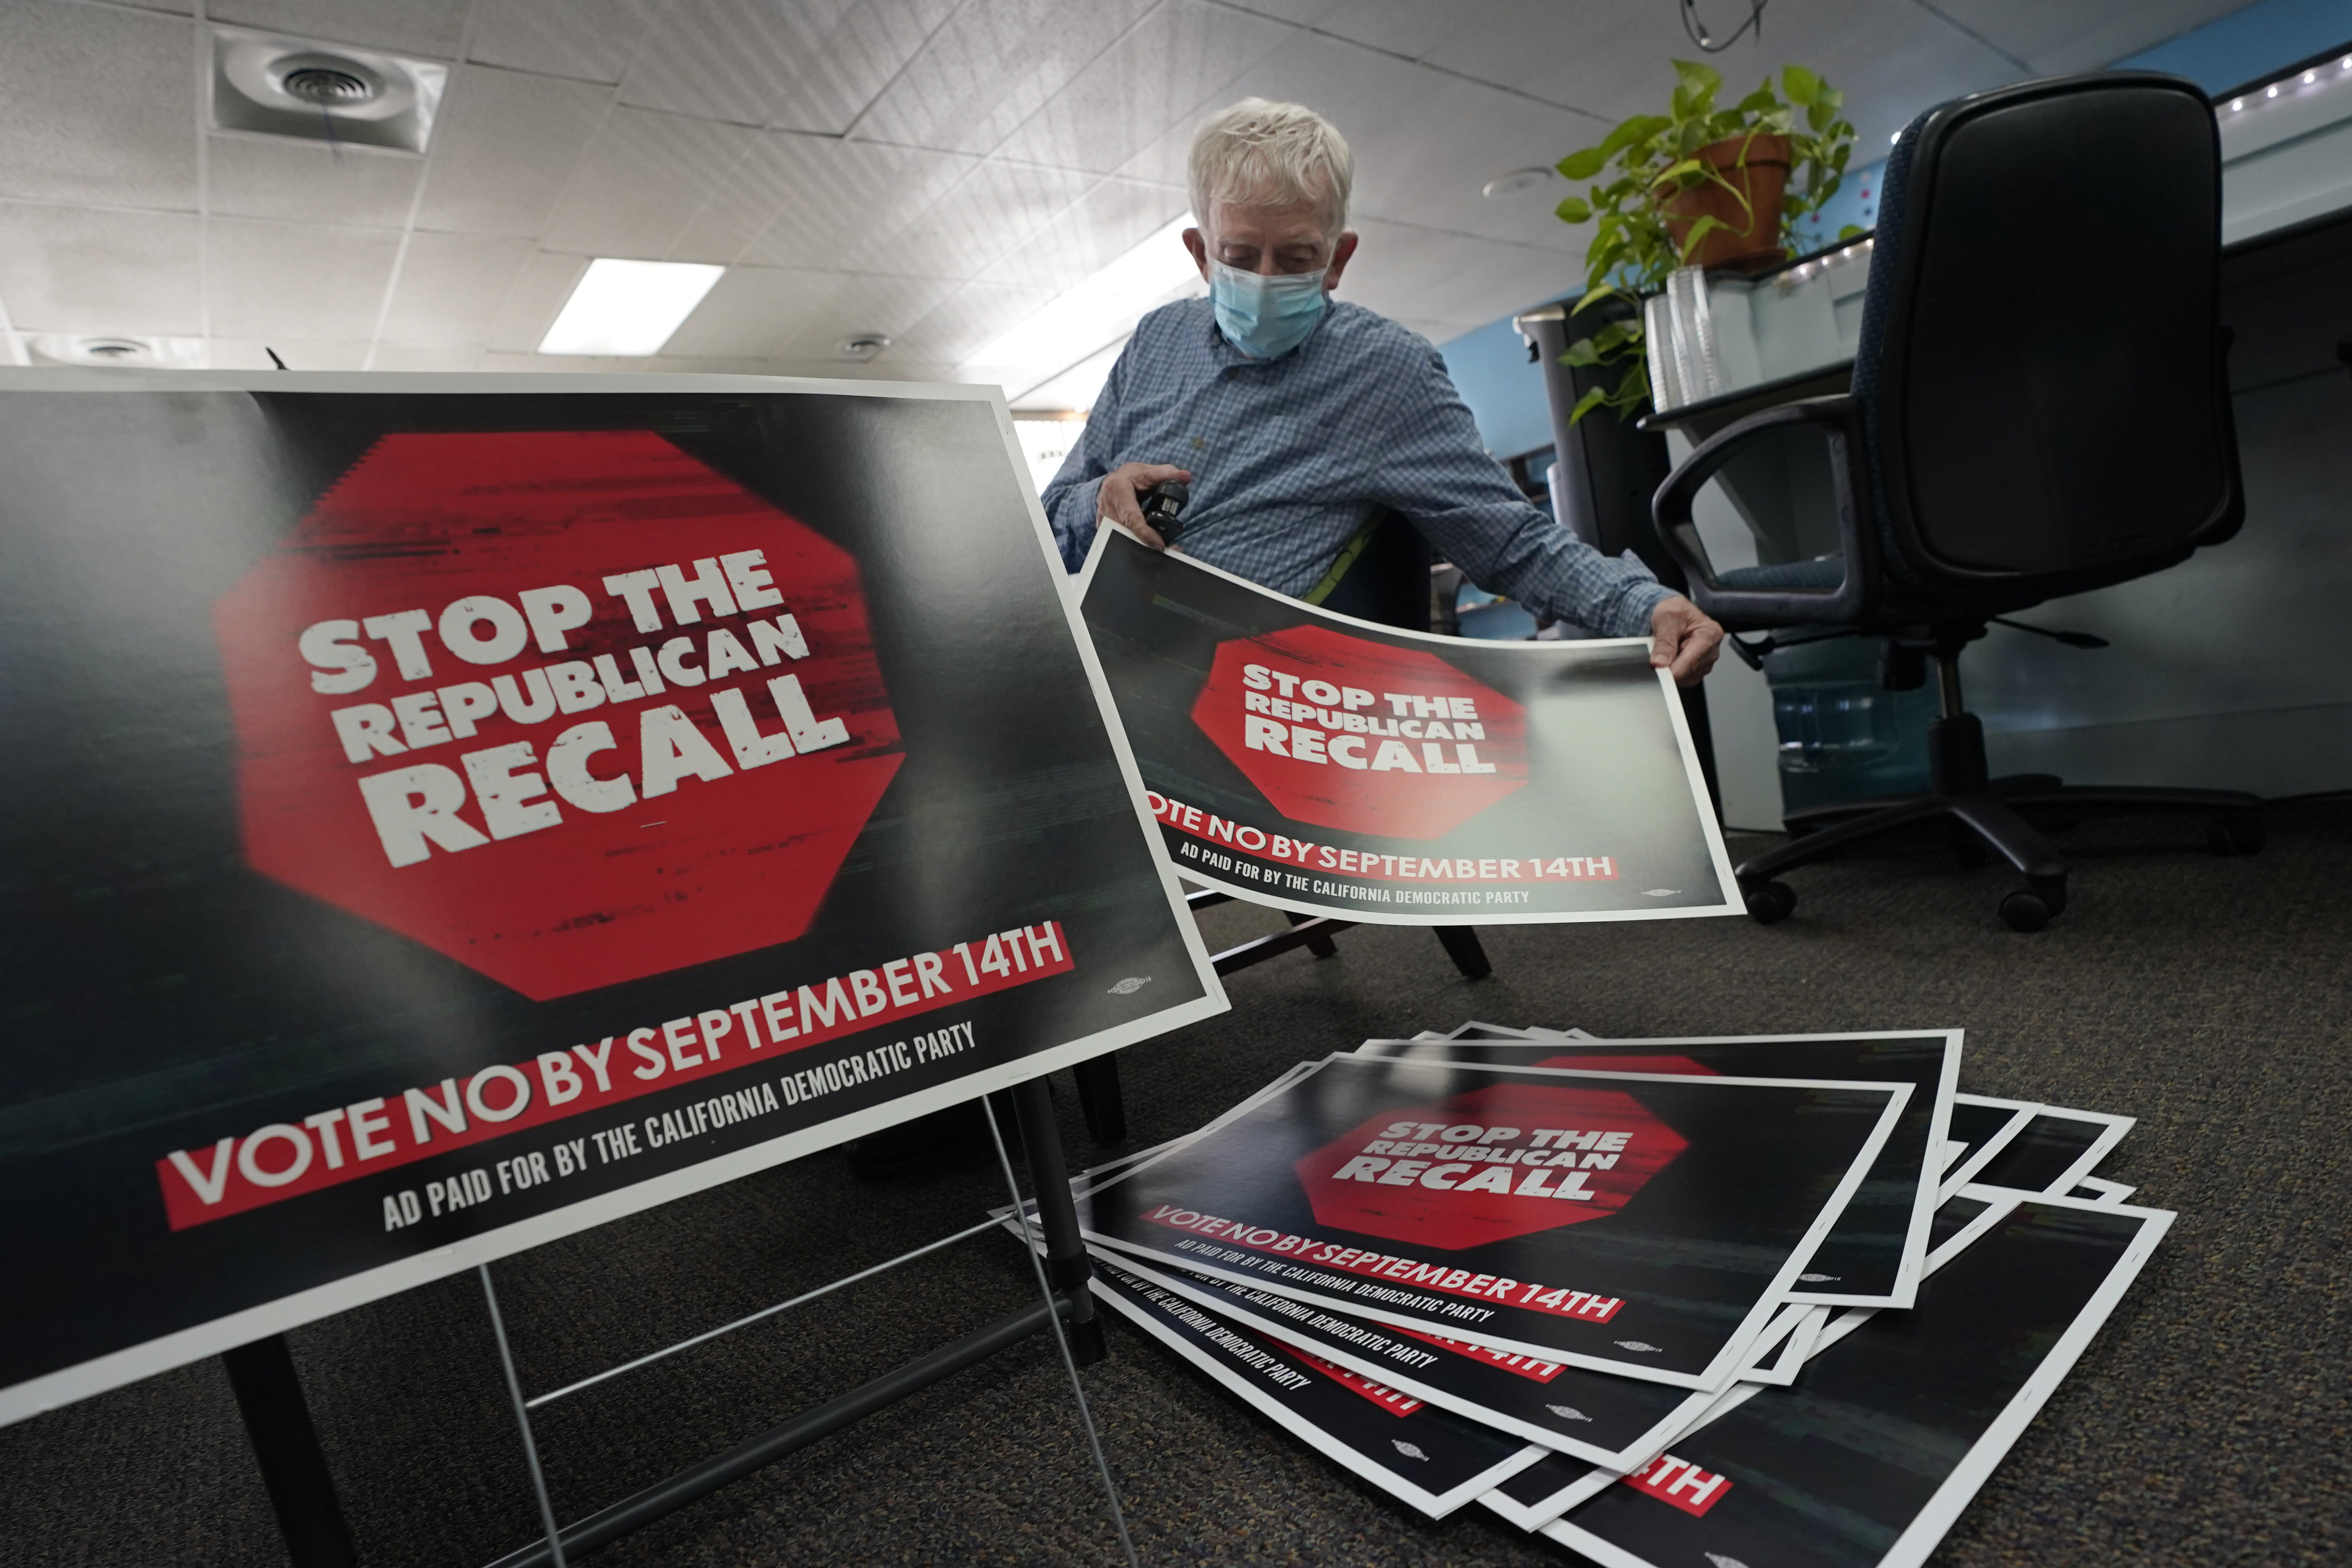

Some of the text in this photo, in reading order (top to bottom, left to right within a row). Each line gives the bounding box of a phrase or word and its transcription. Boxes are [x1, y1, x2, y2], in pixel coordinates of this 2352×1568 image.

[298, 549, 784, 694] STOP THE
[331, 614, 810, 763] REPUBLICAN
[1243, 664, 1478, 720] STOP THE
[1245, 690, 1485, 741] REPUBLICAN
[358, 674, 850, 868] RECALL
[1244, 715, 1497, 774] RECALL
[1146, 790, 1612, 879] OTE NO BY SEPTEMBER 14TH
[1181, 842, 1529, 904] AD PAID FOR BY THE CALIFORNIA DEMOCRATIC PARTY
[168, 921, 1064, 1205] VOTE NO BY SEPTEMBER 14TH
[383, 1022, 976, 1231] AD PAID FOR BY THE CALIFORNIA DEMOCRATIC PARTY
[1361, 1140, 1620, 1170] REPUBLICAN
[1379, 1121, 1633, 1152] STOP THE
[1332, 1155, 1595, 1201] RECALL
[1153, 1205, 1620, 1318] VOTE NO BY SEPTEMBER 14TH
[1174, 1239, 1495, 1323] AD PAID FOR BY THE CALIFORNIA DEMOCRATIC PARTY
[1131, 1281, 1155, 1291] BY
[1143, 1287, 1171, 1302] THE
[1158, 1297, 1209, 1333] CALIFORNIA
[1205, 1326, 1270, 1368] DEMOCRATIC
[1263, 1357, 1312, 1391] PARTY
[1244, 1290, 1315, 1321] CALIFORNIA
[1307, 1314, 1392, 1351] DEMOCRATIC
[1383, 1343, 1438, 1368] PARTY
[1631, 1454, 1726, 1506] TH
